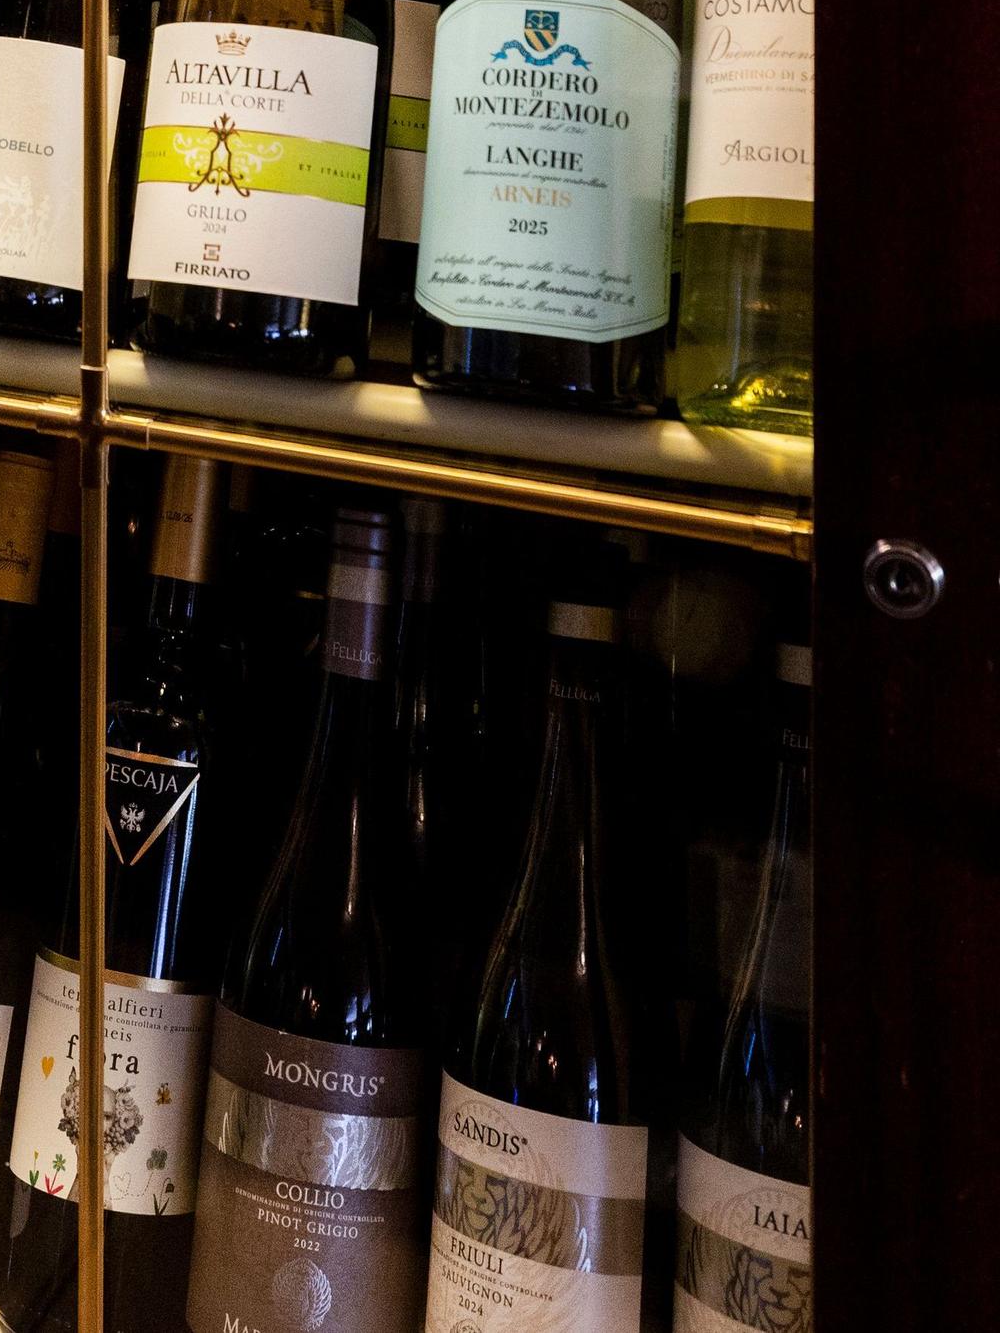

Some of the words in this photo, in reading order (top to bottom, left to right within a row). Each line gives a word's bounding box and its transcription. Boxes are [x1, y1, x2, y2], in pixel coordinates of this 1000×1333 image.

[165, 58, 313, 96] ALTAVILLA
[482, 68, 598, 95] CORDERO
[704, 70, 776, 85] VERMENTINO
[781, 70, 795, 81] DI
[180, 90, 224, 106] DELLA
[230, 94, 286, 113] CORTE
[453, 96, 629, 131] MONTEZEMOLO
[486, 145, 583, 173] LANGHE
[720, 139, 815, 166] ARGIOL
[490, 184, 575, 208] ARNEIS
[187, 204, 247, 223] GRILLO
[202, 223, 227, 234] 2024
[508, 218, 549, 237] 2025
[174, 261, 250, 281] FIRRIATO
[107, 997, 164, 1019] alfieri
[116, 1018, 161, 1030] controllata
[264, 1052, 379, 1097] MONGRIS
[453, 1112, 522, 1156] SANDIS
[235, 1187, 290, 1211] DENOMINAZIONE
[293, 1206, 301, 1214] DI
[304, 1209, 335, 1220] ORIGINE
[275, 1182, 345, 1210] COLLIO
[257, 1208, 302, 1231] PINOT
[306, 1221, 358, 1239] GRIGIO
[293, 1238, 321, 1252] 2022
[450, 1235, 504, 1276] FRIULI
[440, 1266, 514, 1308] SAUVIGNON
[458, 1295, 484, 1317] 2024
